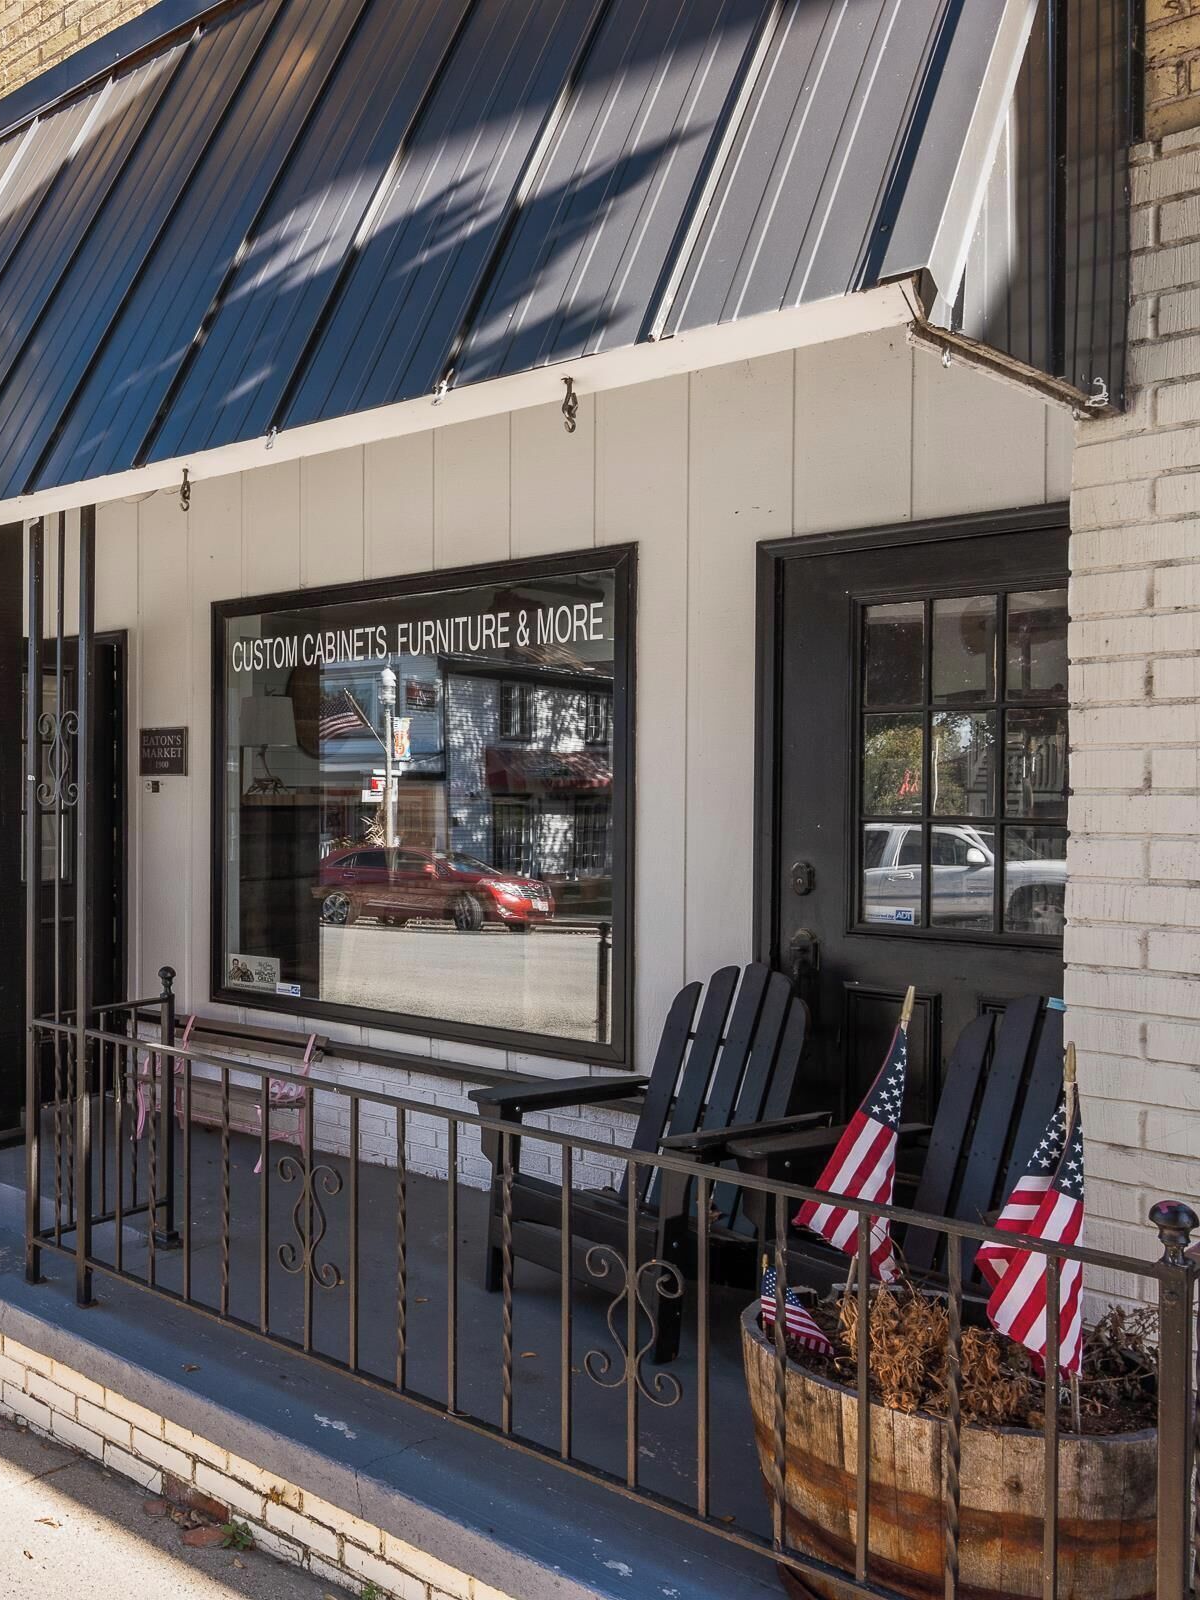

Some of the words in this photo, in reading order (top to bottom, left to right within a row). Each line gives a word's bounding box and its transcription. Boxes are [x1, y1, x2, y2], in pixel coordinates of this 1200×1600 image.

[232, 635, 298, 673] CUSTOM
[302, 624, 392, 667] CABINETS,
[397, 611, 510, 657] FURNITURE
[517, 609, 530, 647] &
[537, 602, 604, 645] MORE
[143, 735, 182, 746] EATON'S
[143, 747, 182, 758] MARKET
[896, 911, 912, 920] ADT
